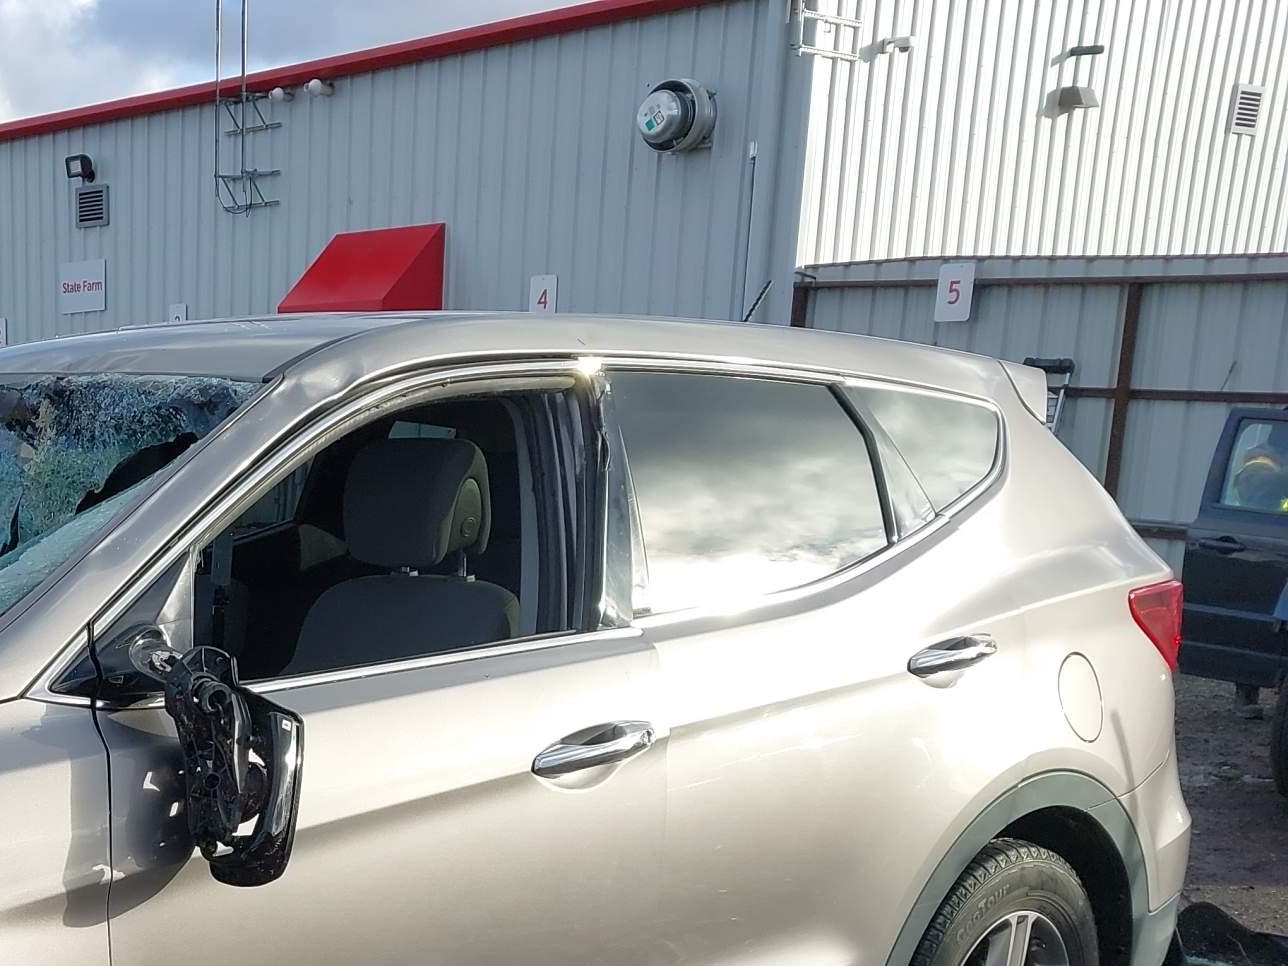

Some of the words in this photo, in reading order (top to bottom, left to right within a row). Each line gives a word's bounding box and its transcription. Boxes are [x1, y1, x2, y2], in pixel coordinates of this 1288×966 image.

[62, 281, 81, 294] State
[82, 280, 103, 293] Farm
[947, 280, 961, 305] 5
[537, 288, 548, 310] 4
